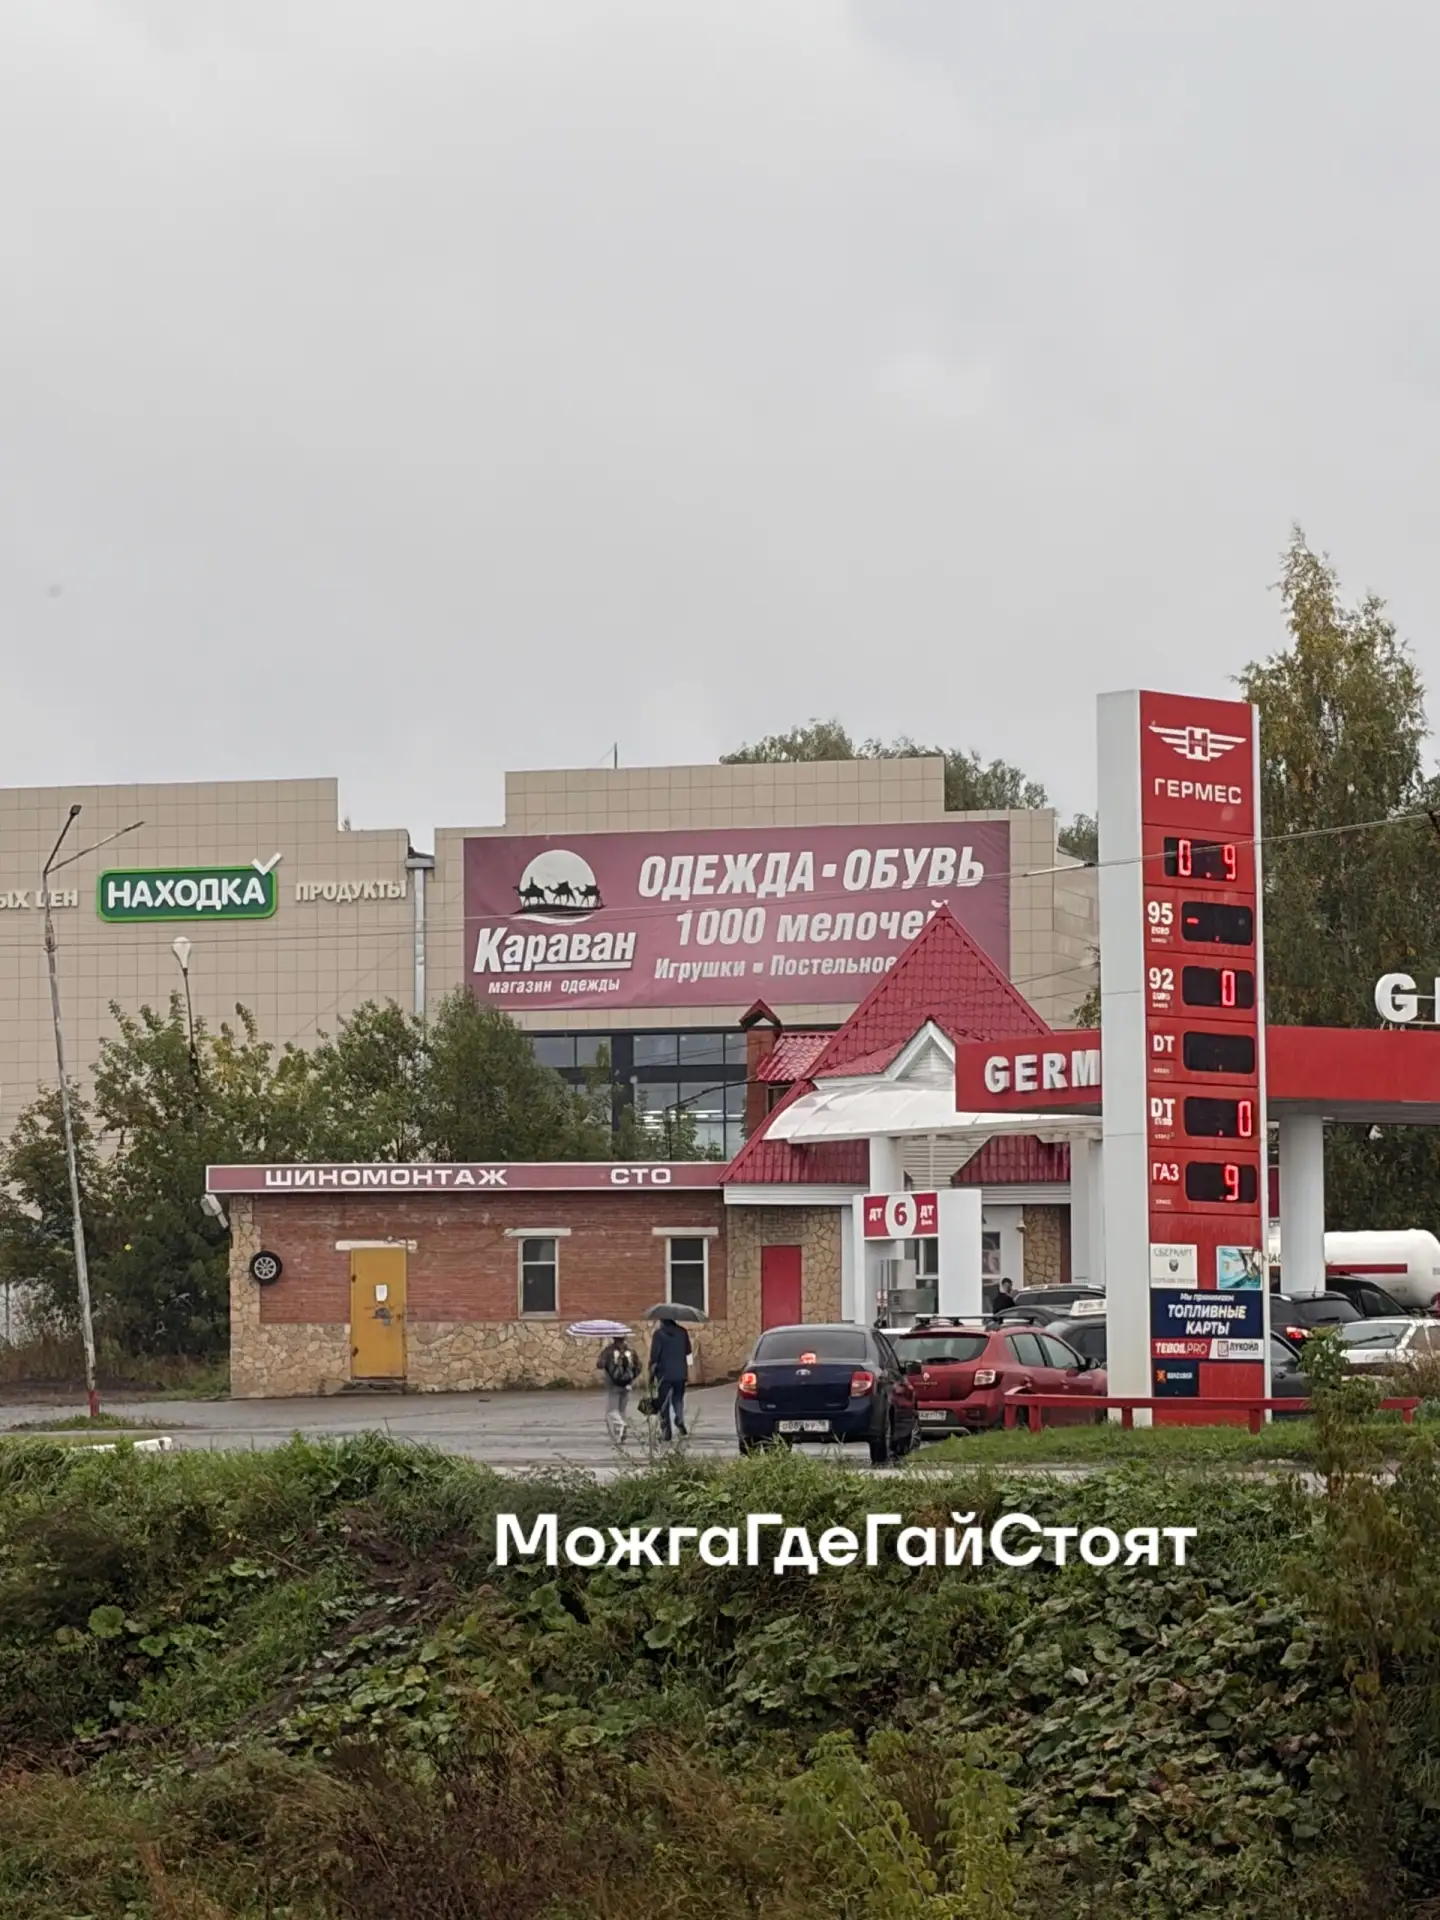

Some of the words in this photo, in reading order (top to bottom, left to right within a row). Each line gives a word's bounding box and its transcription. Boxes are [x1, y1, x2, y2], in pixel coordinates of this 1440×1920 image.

[1154, 777, 1242, 804] ГЕРМЕС
[638, 851, 815, 901] ОДЕЖДА
[843, 846, 984, 891] ОБУВЬ
[108, 877, 266, 911] НАХОДКА
[296, 879, 407, 903] ПРОДУКТЫ
[676, 906, 766, 945] 1000
[776, 899, 948, 942] мелоче
[1147, 900, 1174, 925] 95
[473, 927, 636, 973] Караван
[654, 958, 745, 983] Игрушки
[1148, 967, 1174, 991] 92
[488, 979, 551, 994] магазин
[560, 977, 620, 993] одежды
[1153, 1034, 1175, 1053] DT
[1150, 1097, 1176, 1118] DT
[265, 1169, 507, 1187] ШИНОМОНТАЖ
[610, 1168, 671, 1185] СТО
[1152, 1162, 1179, 1182] ГАЗ
[894, 1202, 907, 1227] 6
[1167, 1304, 1248, 1320] ТОПЛИВНЫЕ
[1185, 1321, 1230, 1335] КАРТЫ
